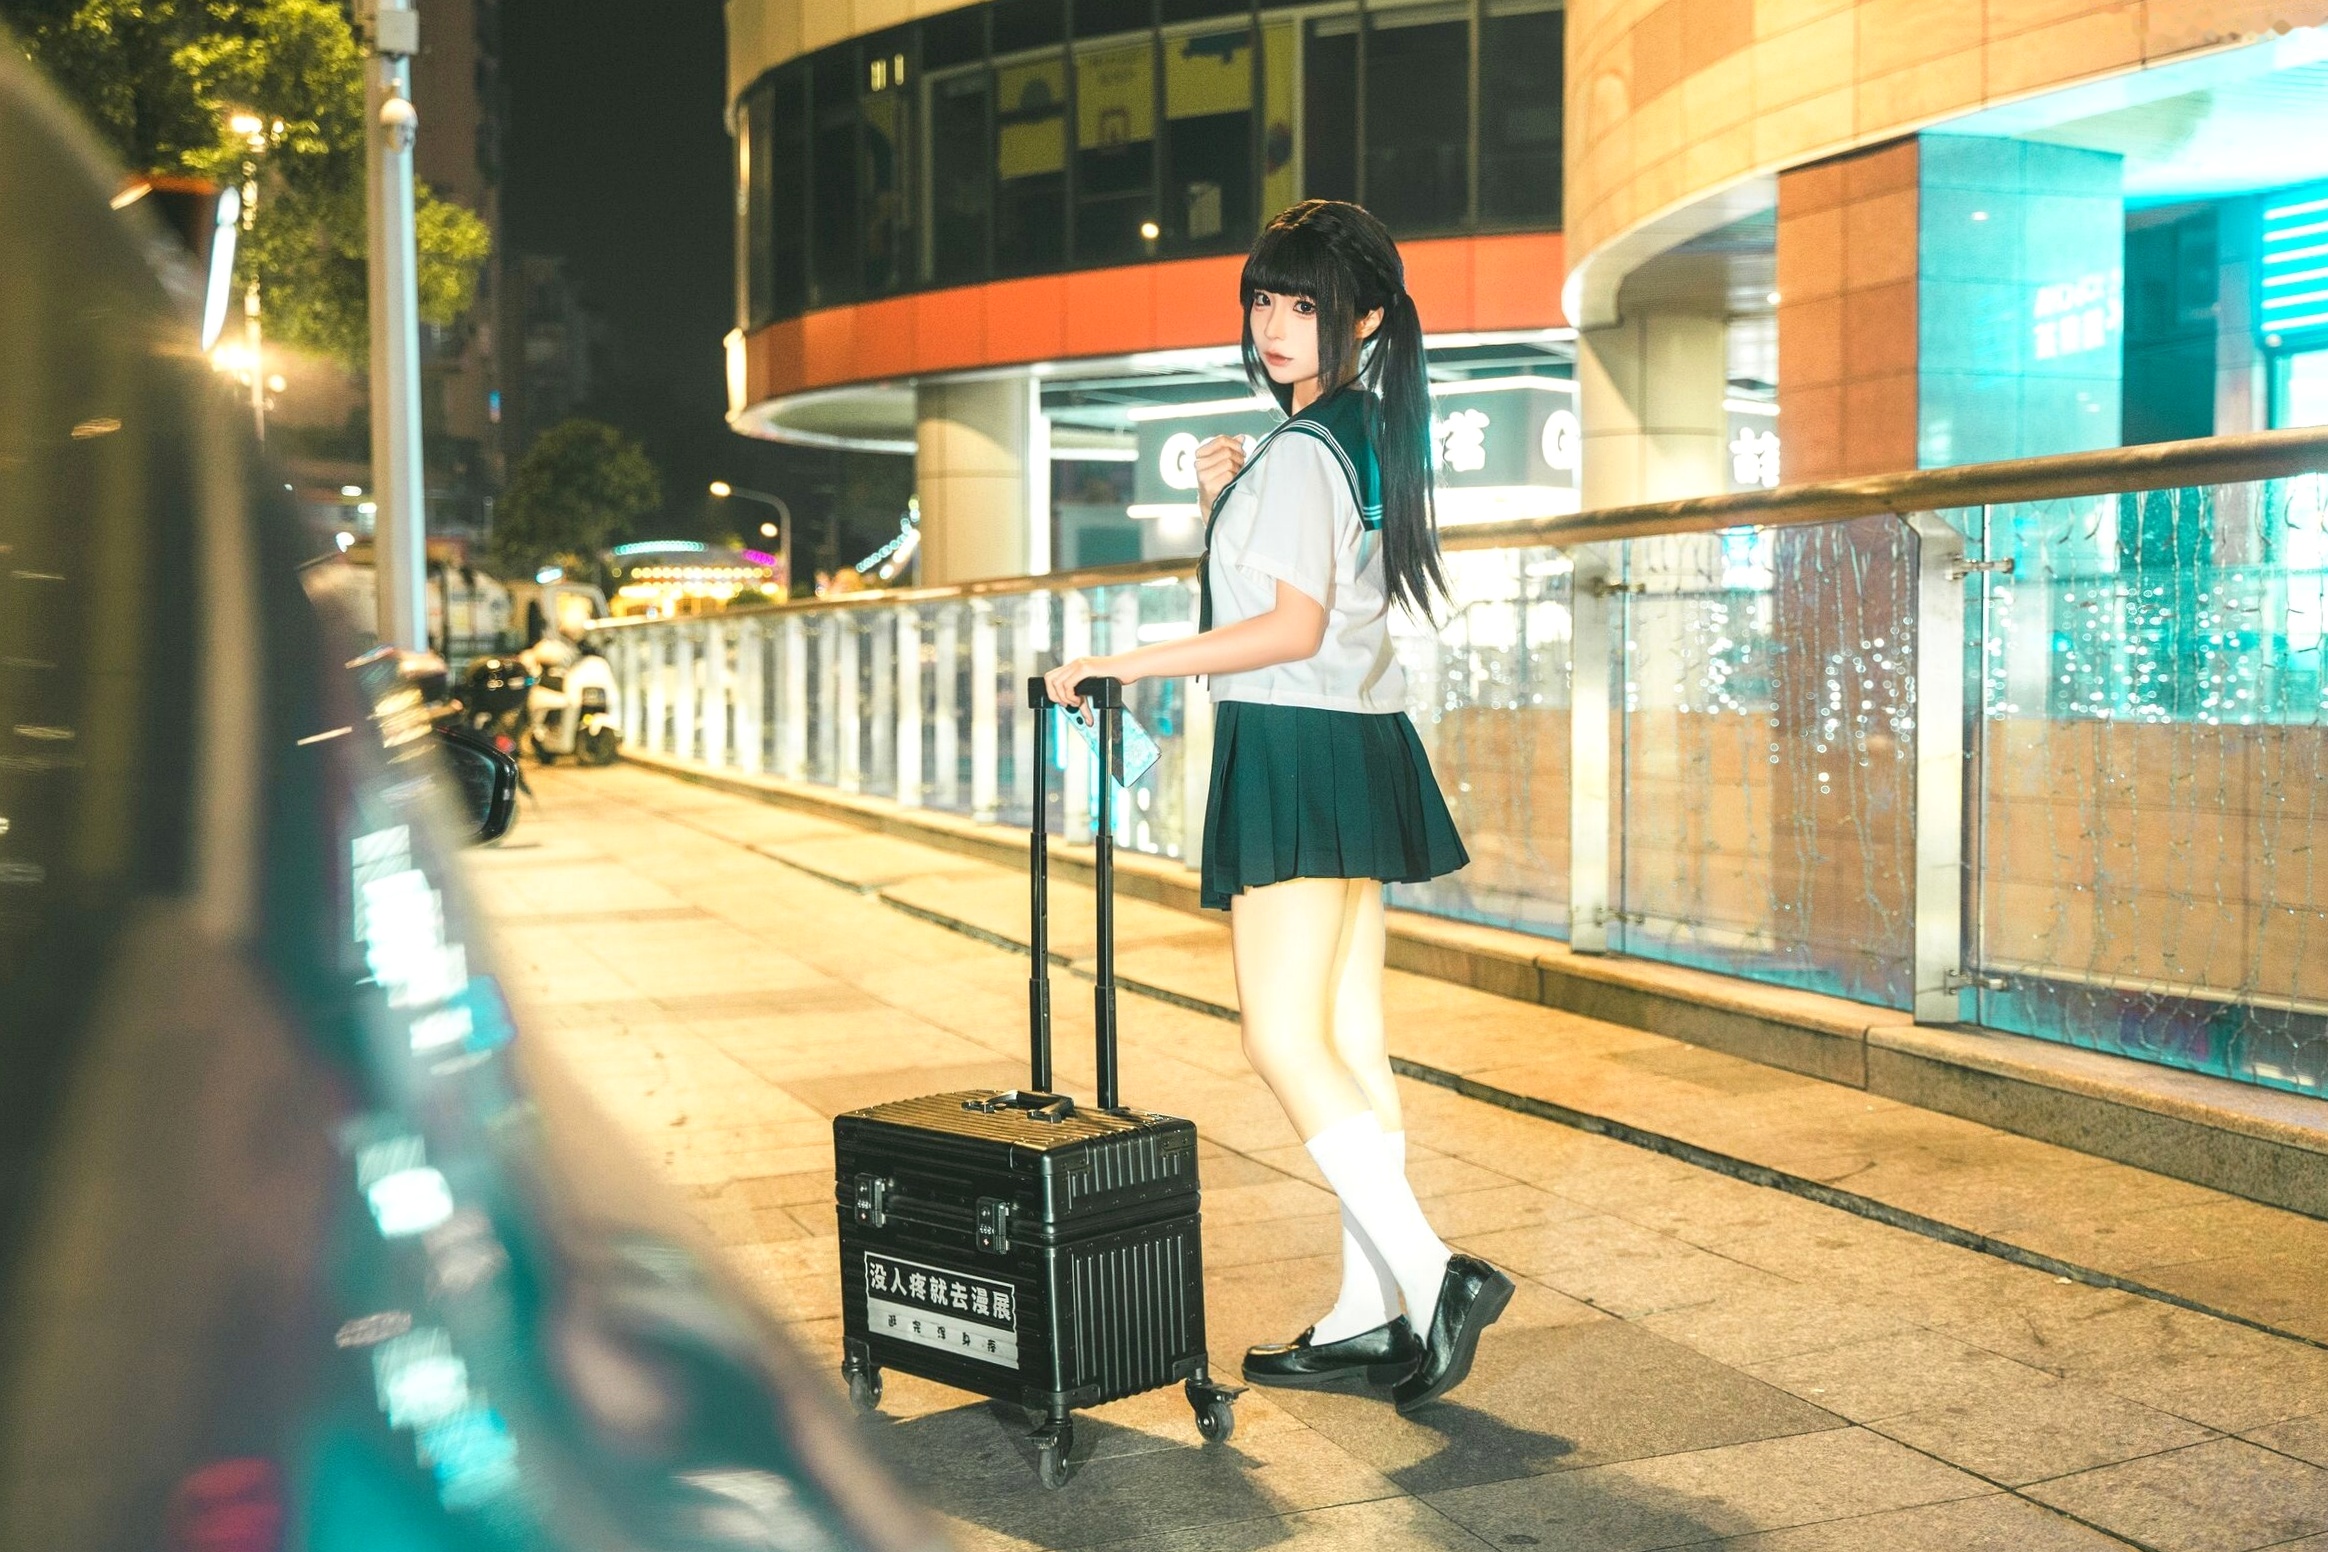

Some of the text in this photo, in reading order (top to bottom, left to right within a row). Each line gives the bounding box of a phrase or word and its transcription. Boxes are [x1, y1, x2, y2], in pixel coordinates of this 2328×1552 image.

[869, 1262, 1012, 1321] 没人疼就去漫展
